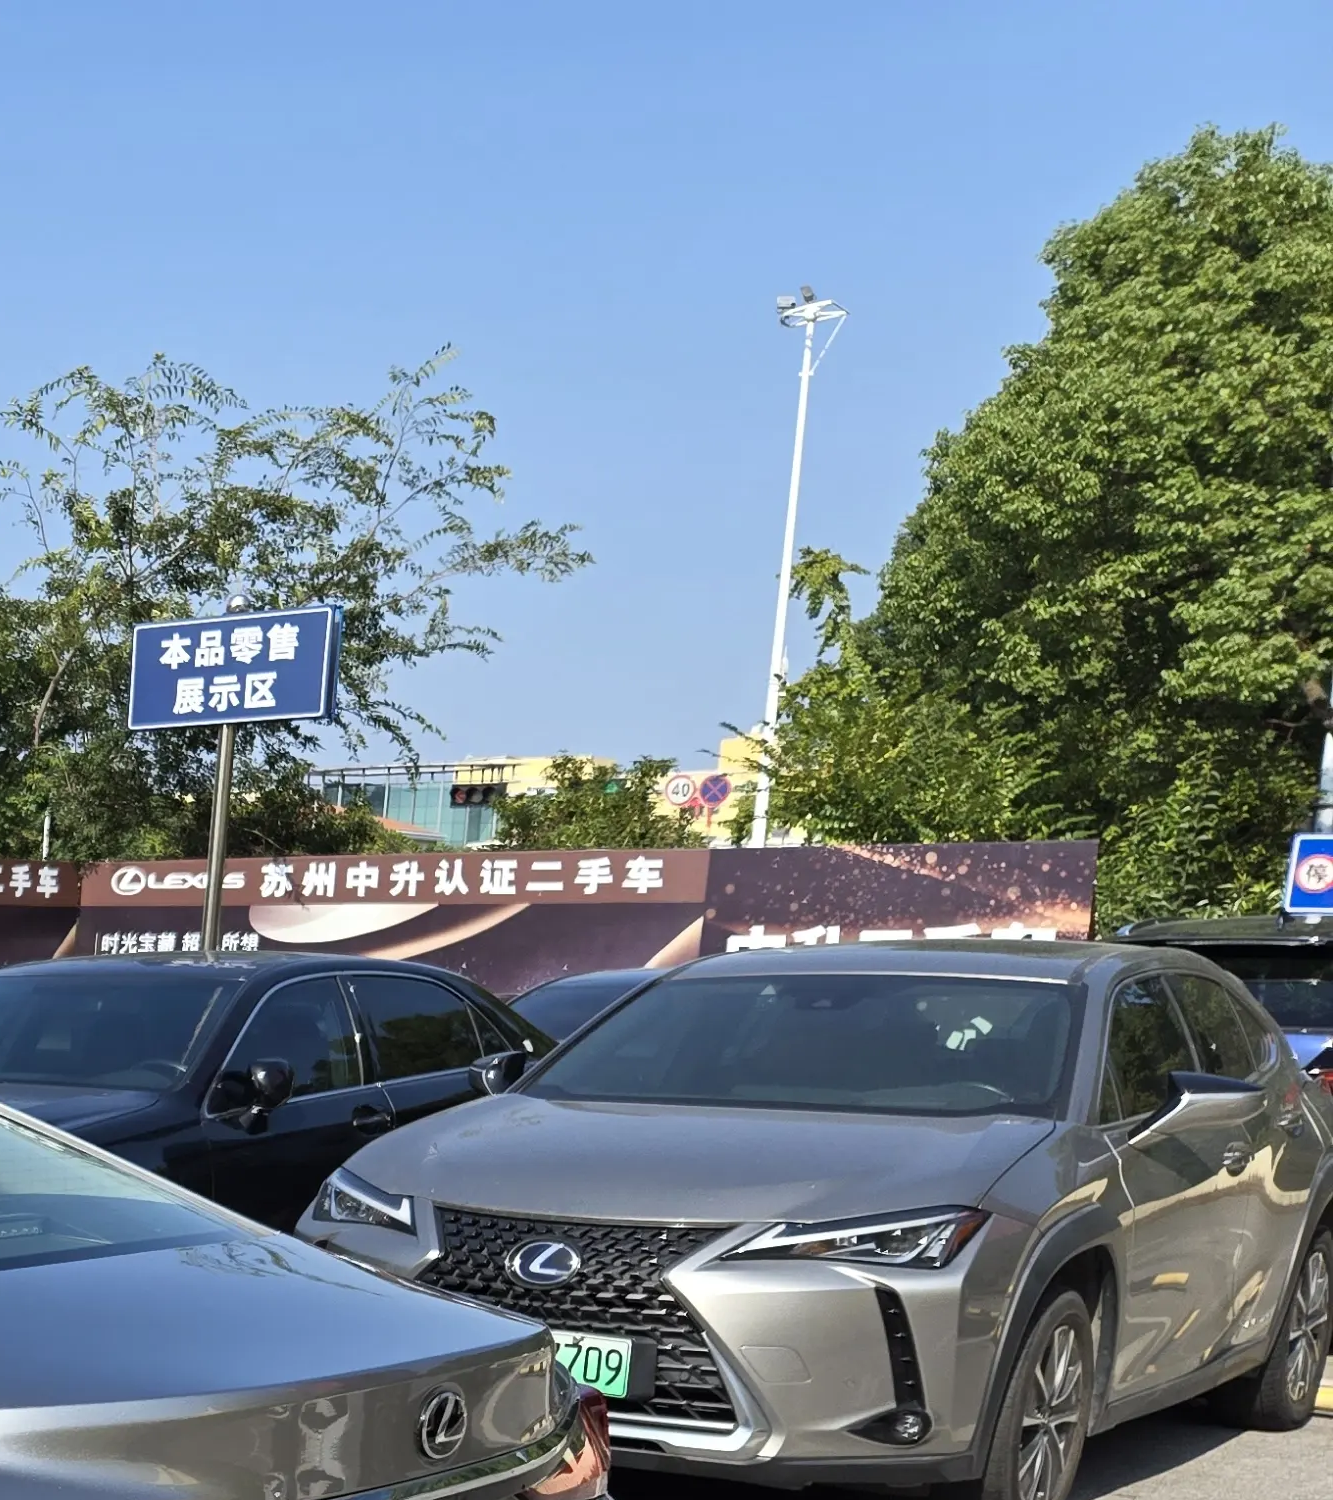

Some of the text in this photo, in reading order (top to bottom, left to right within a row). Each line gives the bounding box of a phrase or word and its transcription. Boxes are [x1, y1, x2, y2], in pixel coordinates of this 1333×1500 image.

[159, 622, 300, 670] 本品零售
[172, 671, 277, 715] 展示区
[671, 783, 691, 798] 40
[259, 856, 664, 897] 苏州中升认证二手车
[1306, 864, 1329, 884] 停
[101, 931, 179, 953] 时光宝藏
